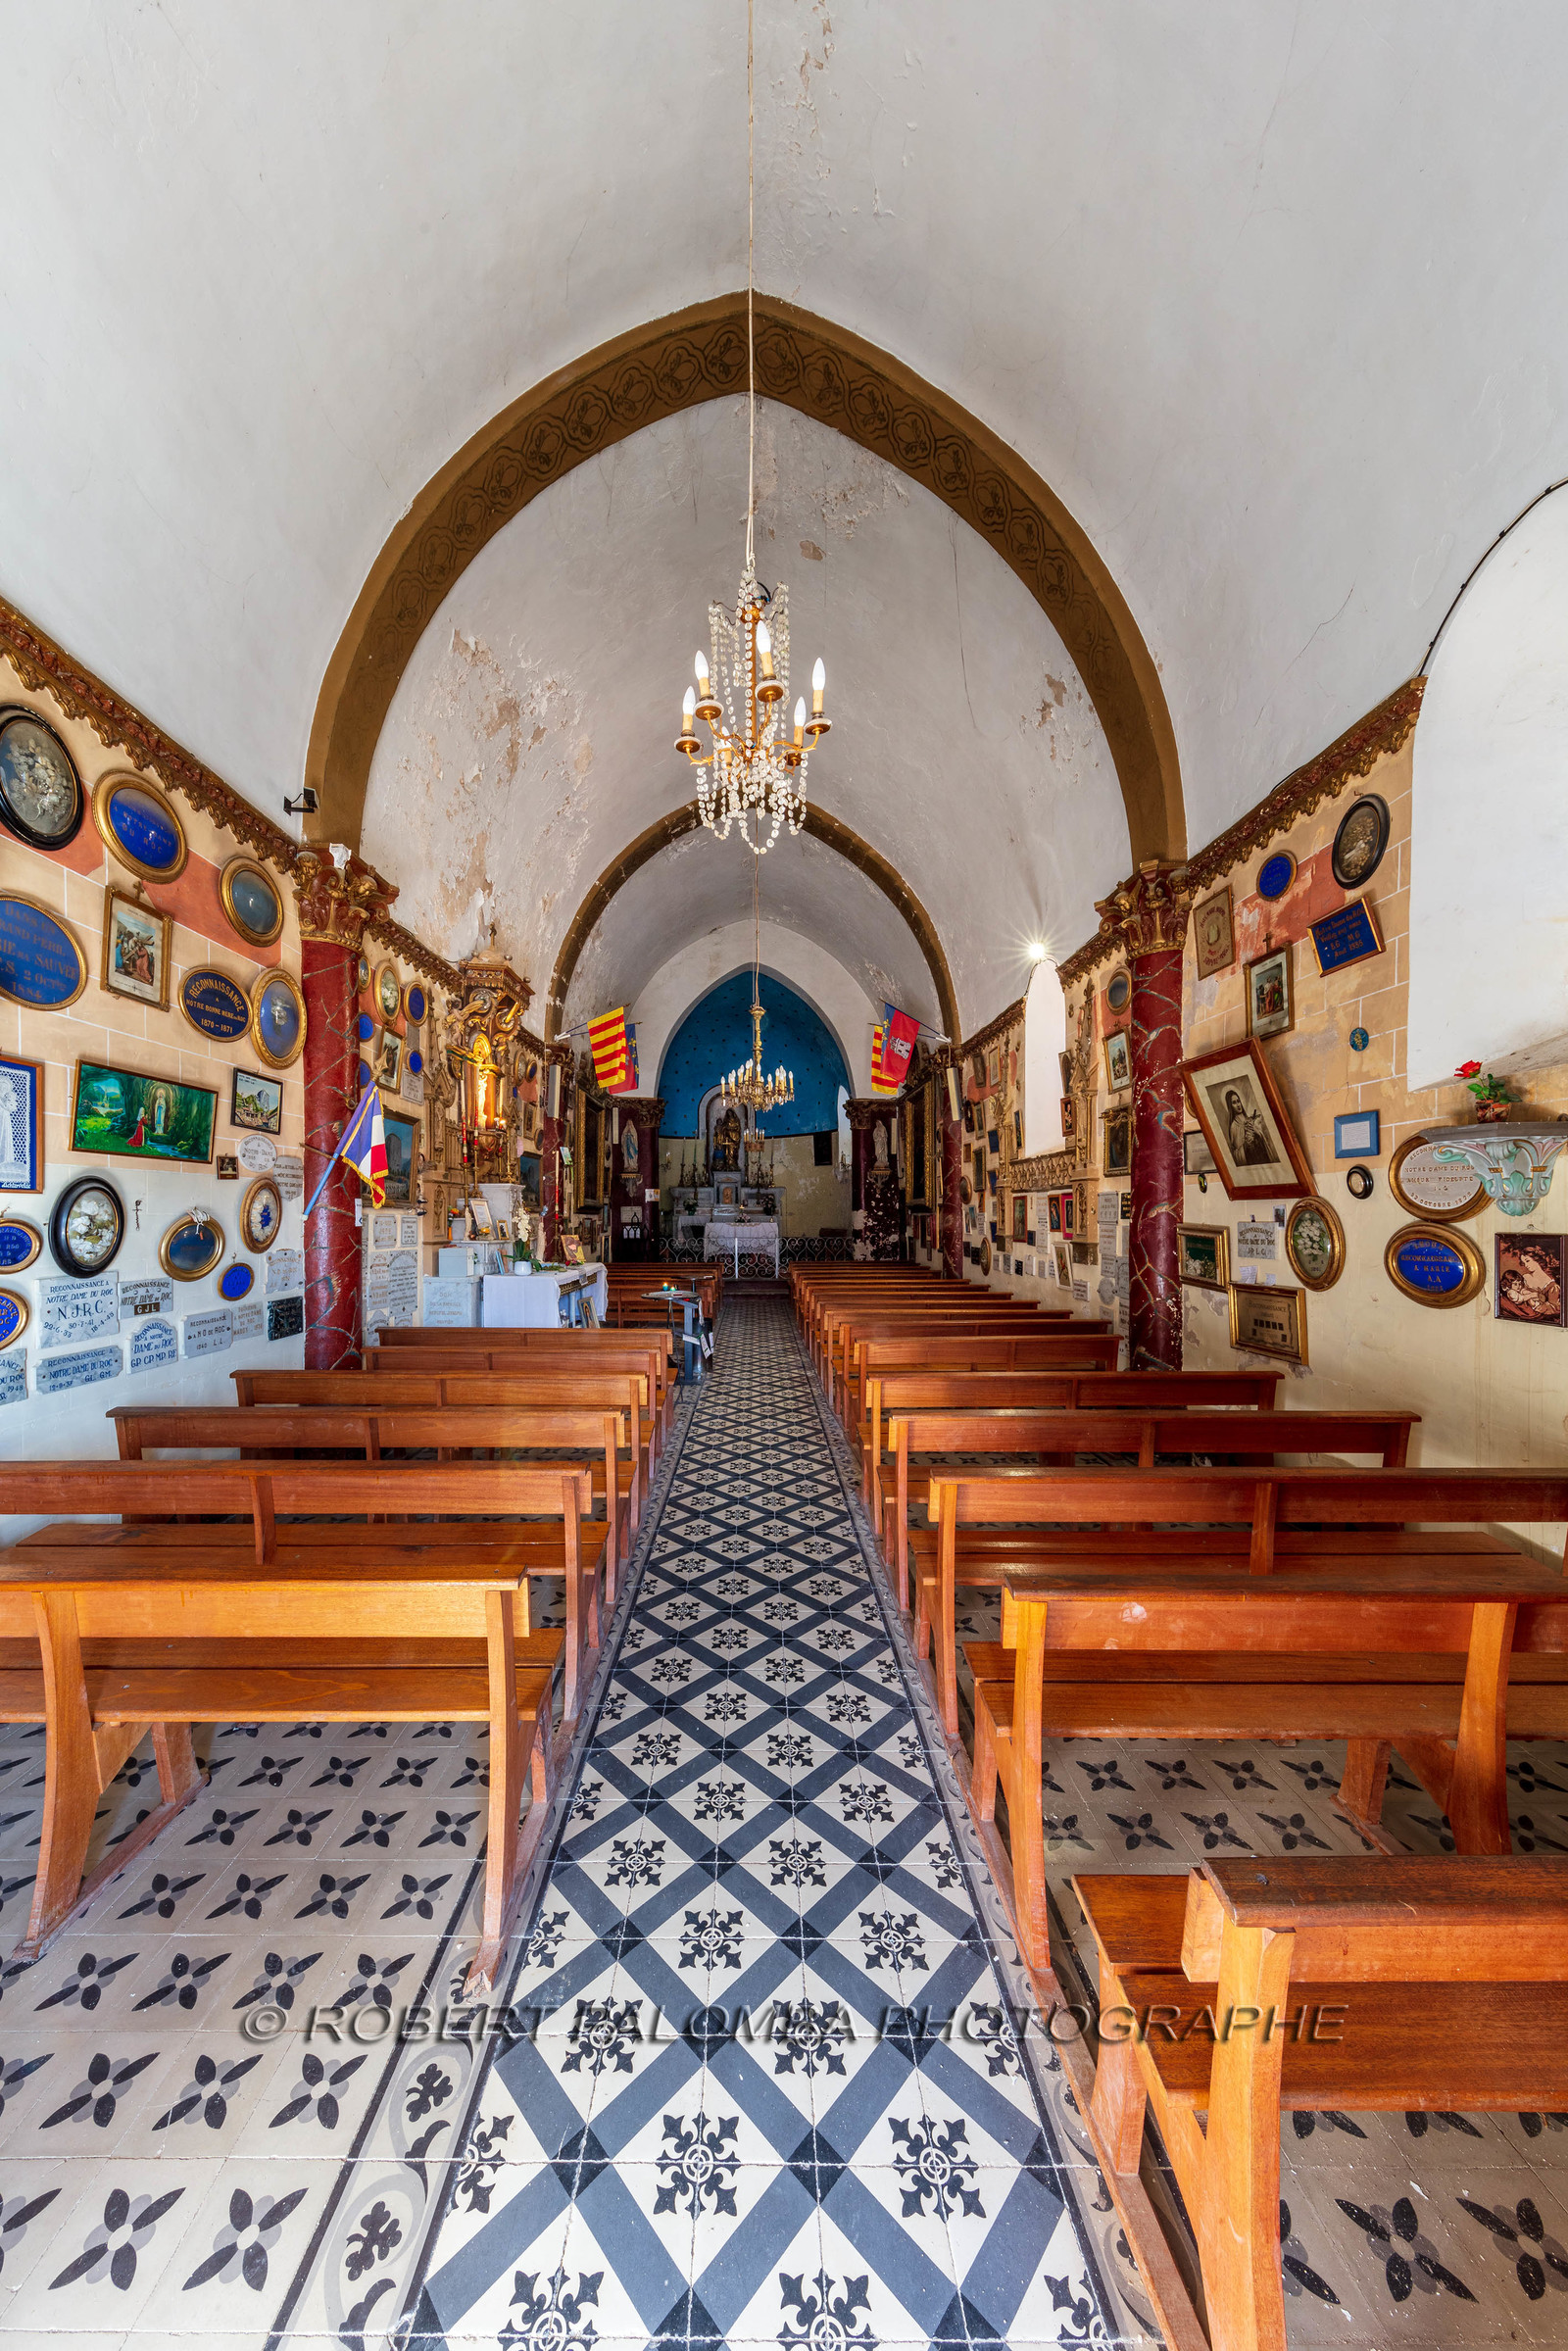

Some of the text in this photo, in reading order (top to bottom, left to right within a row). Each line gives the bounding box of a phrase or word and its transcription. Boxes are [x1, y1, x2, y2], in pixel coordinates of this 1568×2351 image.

[189, 978, 244, 1012] RECONNAISSANCE
[185, 999, 205, 1010] NOTRE
[205, 1004, 221, 1015] BONNE
[201, 1018, 215, 1029] 1870
[220, 1023, 233, 1034] 1871
[1410, 1146, 1437, 1161] RECONNA
[1239, 1226, 1274, 1238] RECONNAISSANCE
[49, 1280, 105, 1294] RECONNAISSANCE
[122, 1281, 171, 1295] RECONNAISSANCE
[46, 1294, 69, 1304] NOTRE
[70, 1292, 88, 1301] DAME
[100, 1288, 114, 1298] ROC
[121, 1295, 139, 1306] NOTRE
[139, 1293, 155, 1304] DAME
[161, 1292, 172, 1302] ROC
[134, 1321, 173, 1343] RECONNAISSANCE
[214, 1325, 225, 1334] ROC
[133, 1342, 154, 1354] DAME
[161, 1338, 174, 1349] ROC
[47, 1350, 106, 1368] RECONNAISSANCE
[9, 1372, 25, 1384] ROC
[49, 1359, 113, 1381] NOTRE DAME DU ROC
